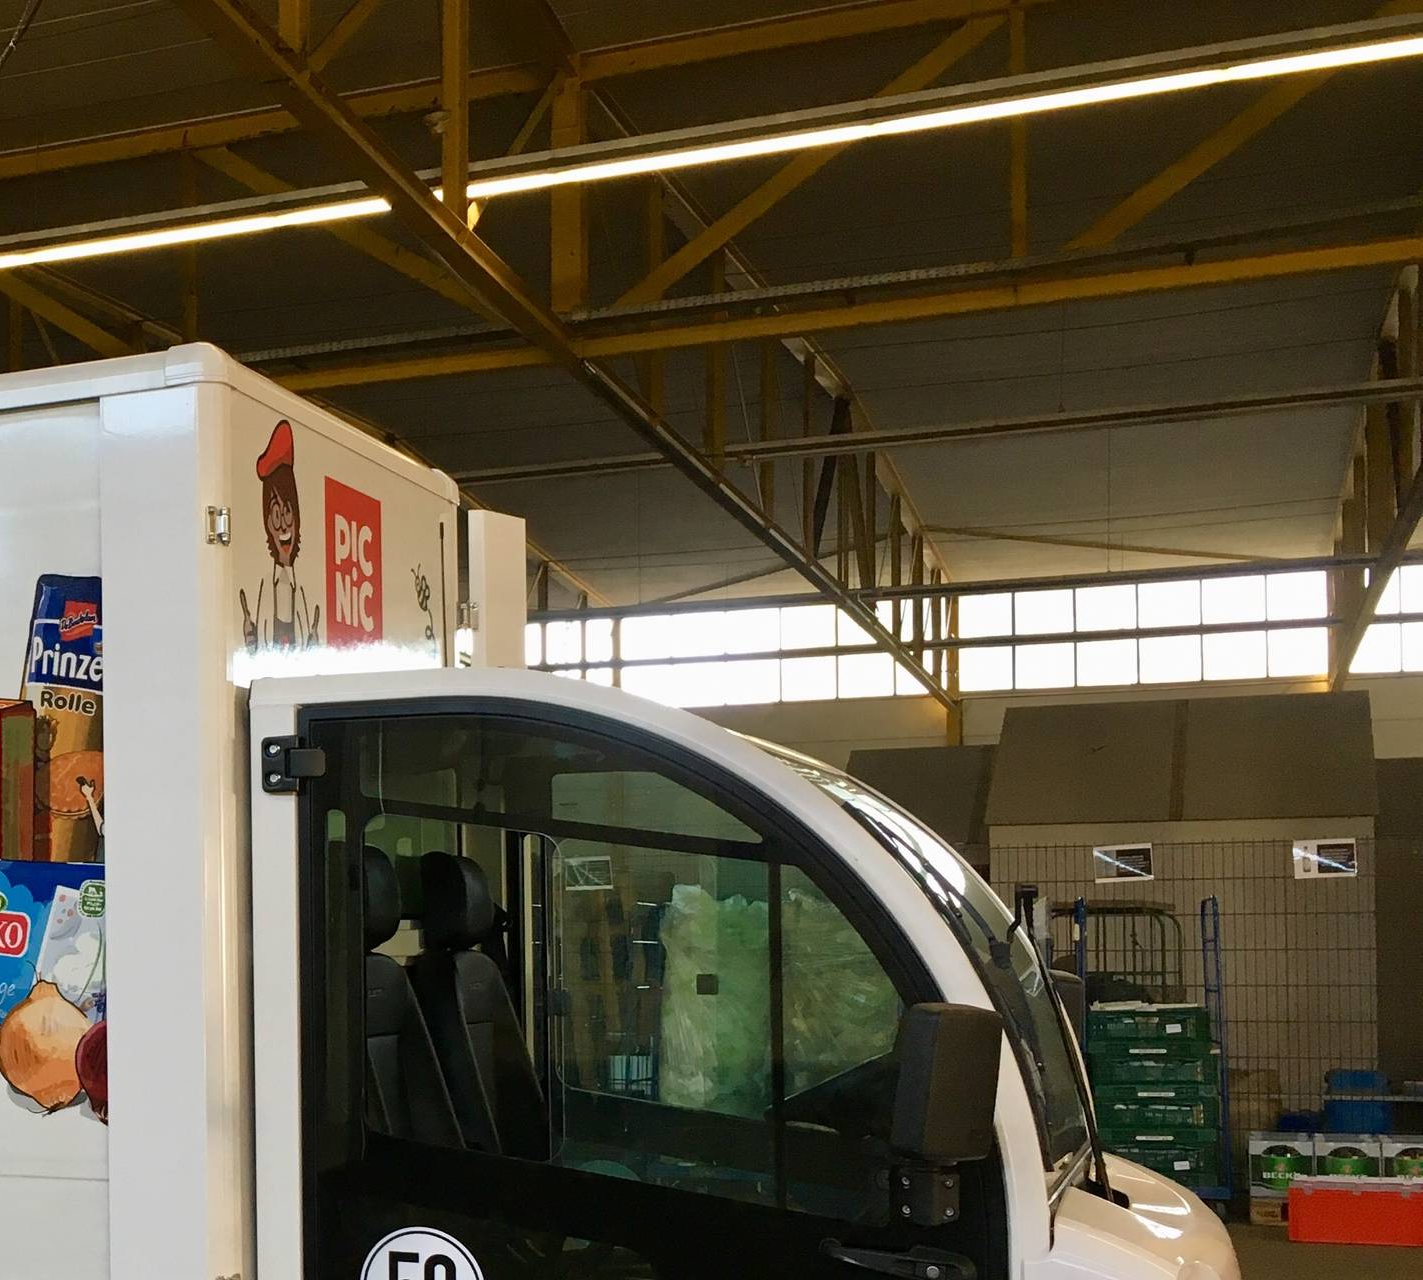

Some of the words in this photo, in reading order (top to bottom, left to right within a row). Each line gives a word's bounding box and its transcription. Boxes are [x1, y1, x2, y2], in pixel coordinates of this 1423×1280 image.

[334, 513, 373, 577] PIC
[31, 636, 103, 682] Prinze
[40, 689, 96, 716] Rolle
